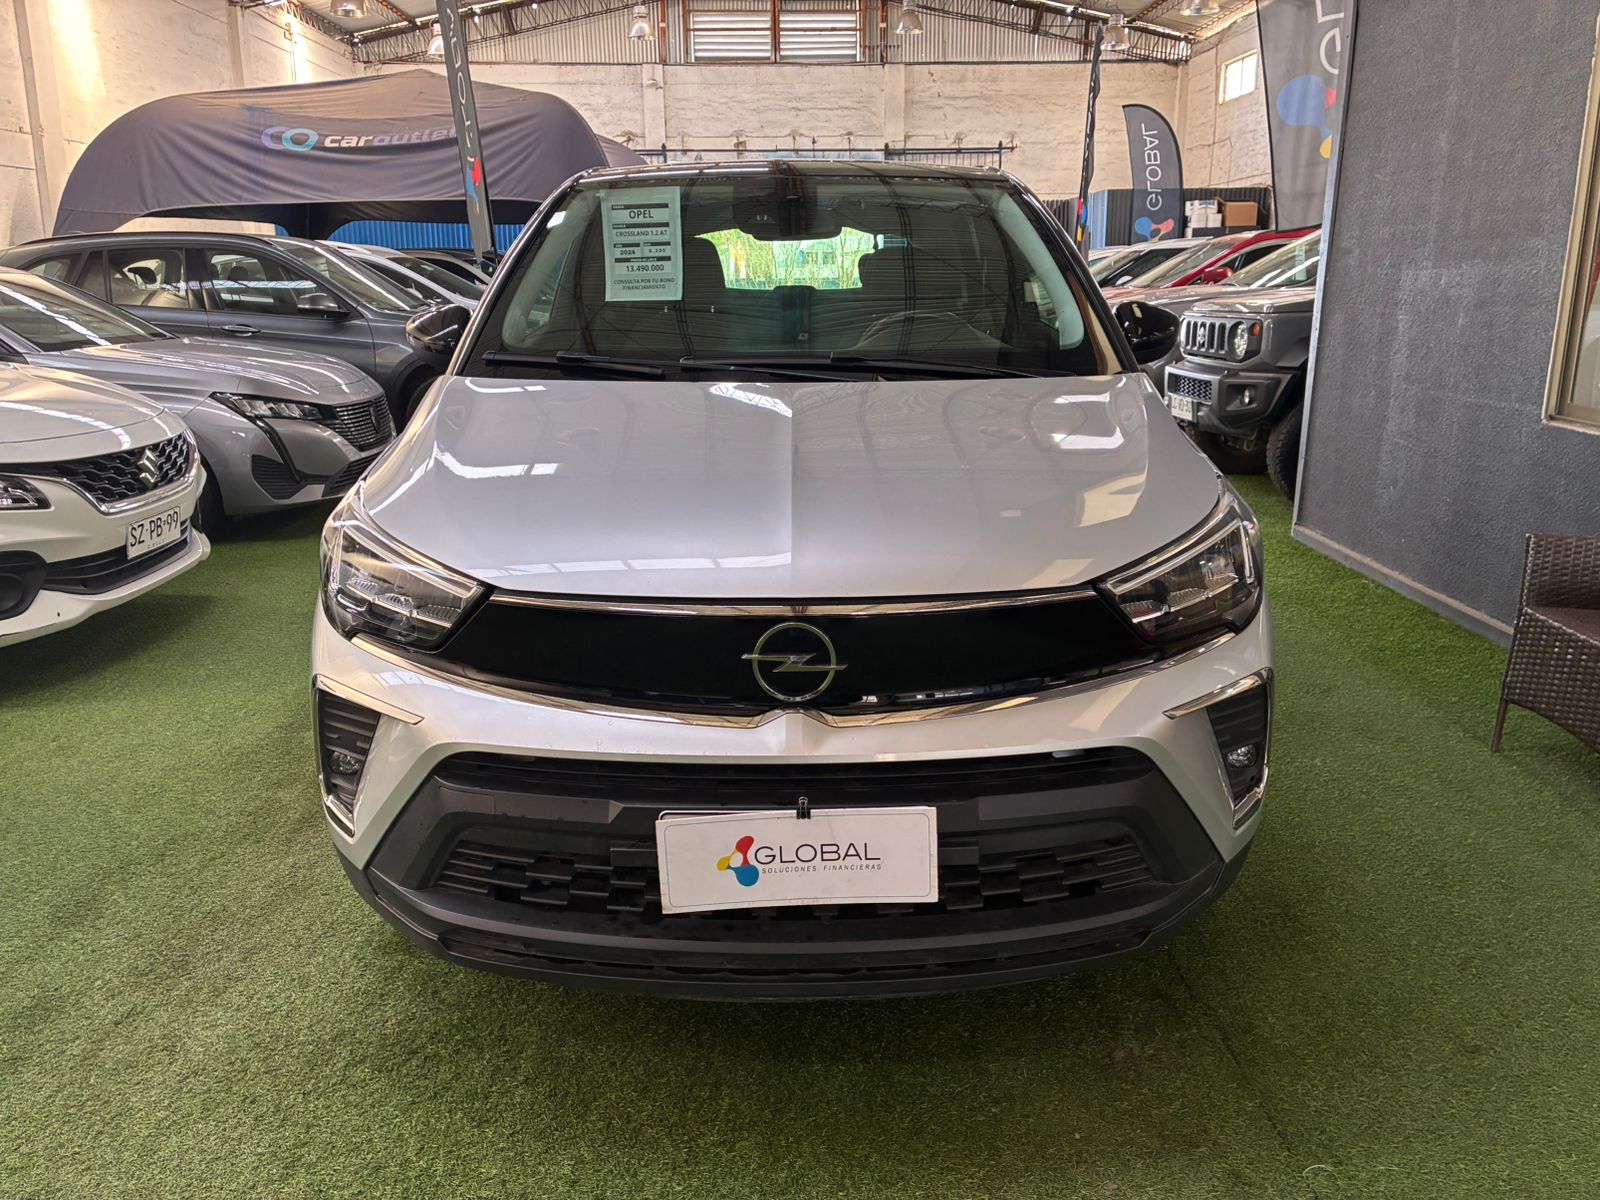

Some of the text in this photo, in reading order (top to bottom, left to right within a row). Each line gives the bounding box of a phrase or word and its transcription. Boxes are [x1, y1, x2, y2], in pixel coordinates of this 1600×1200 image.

[628, 210, 654, 219] OPEL
[615, 230, 649, 238] CROSSLAND
[626, 264, 665, 273] 13.490.000
[754, 842, 881, 865] GLOBAL
[761, 863, 882, 874] SOLUCIONES FINANCIERAS
